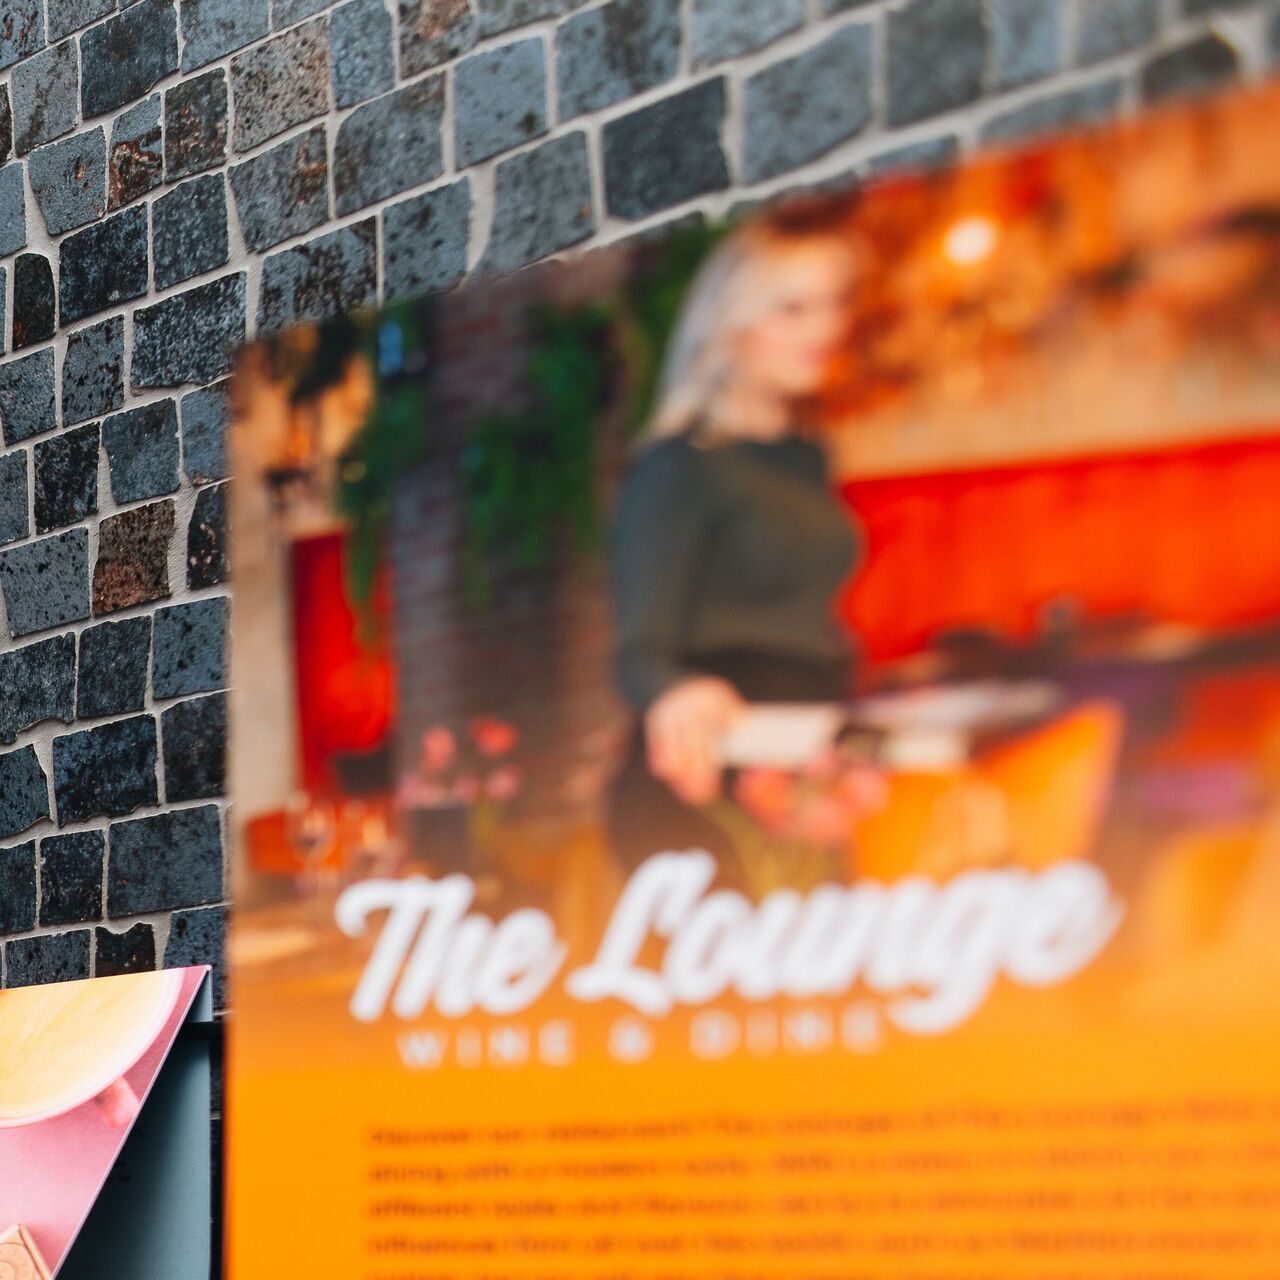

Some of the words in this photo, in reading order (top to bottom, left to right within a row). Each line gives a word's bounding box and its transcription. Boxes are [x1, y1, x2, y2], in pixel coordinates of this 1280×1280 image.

[333, 873, 567, 1023] The
[564, 848, 1127, 1037] Lounge
[396, 1015, 579, 1071] WINE
[689, 1003, 887, 1063] DINE
